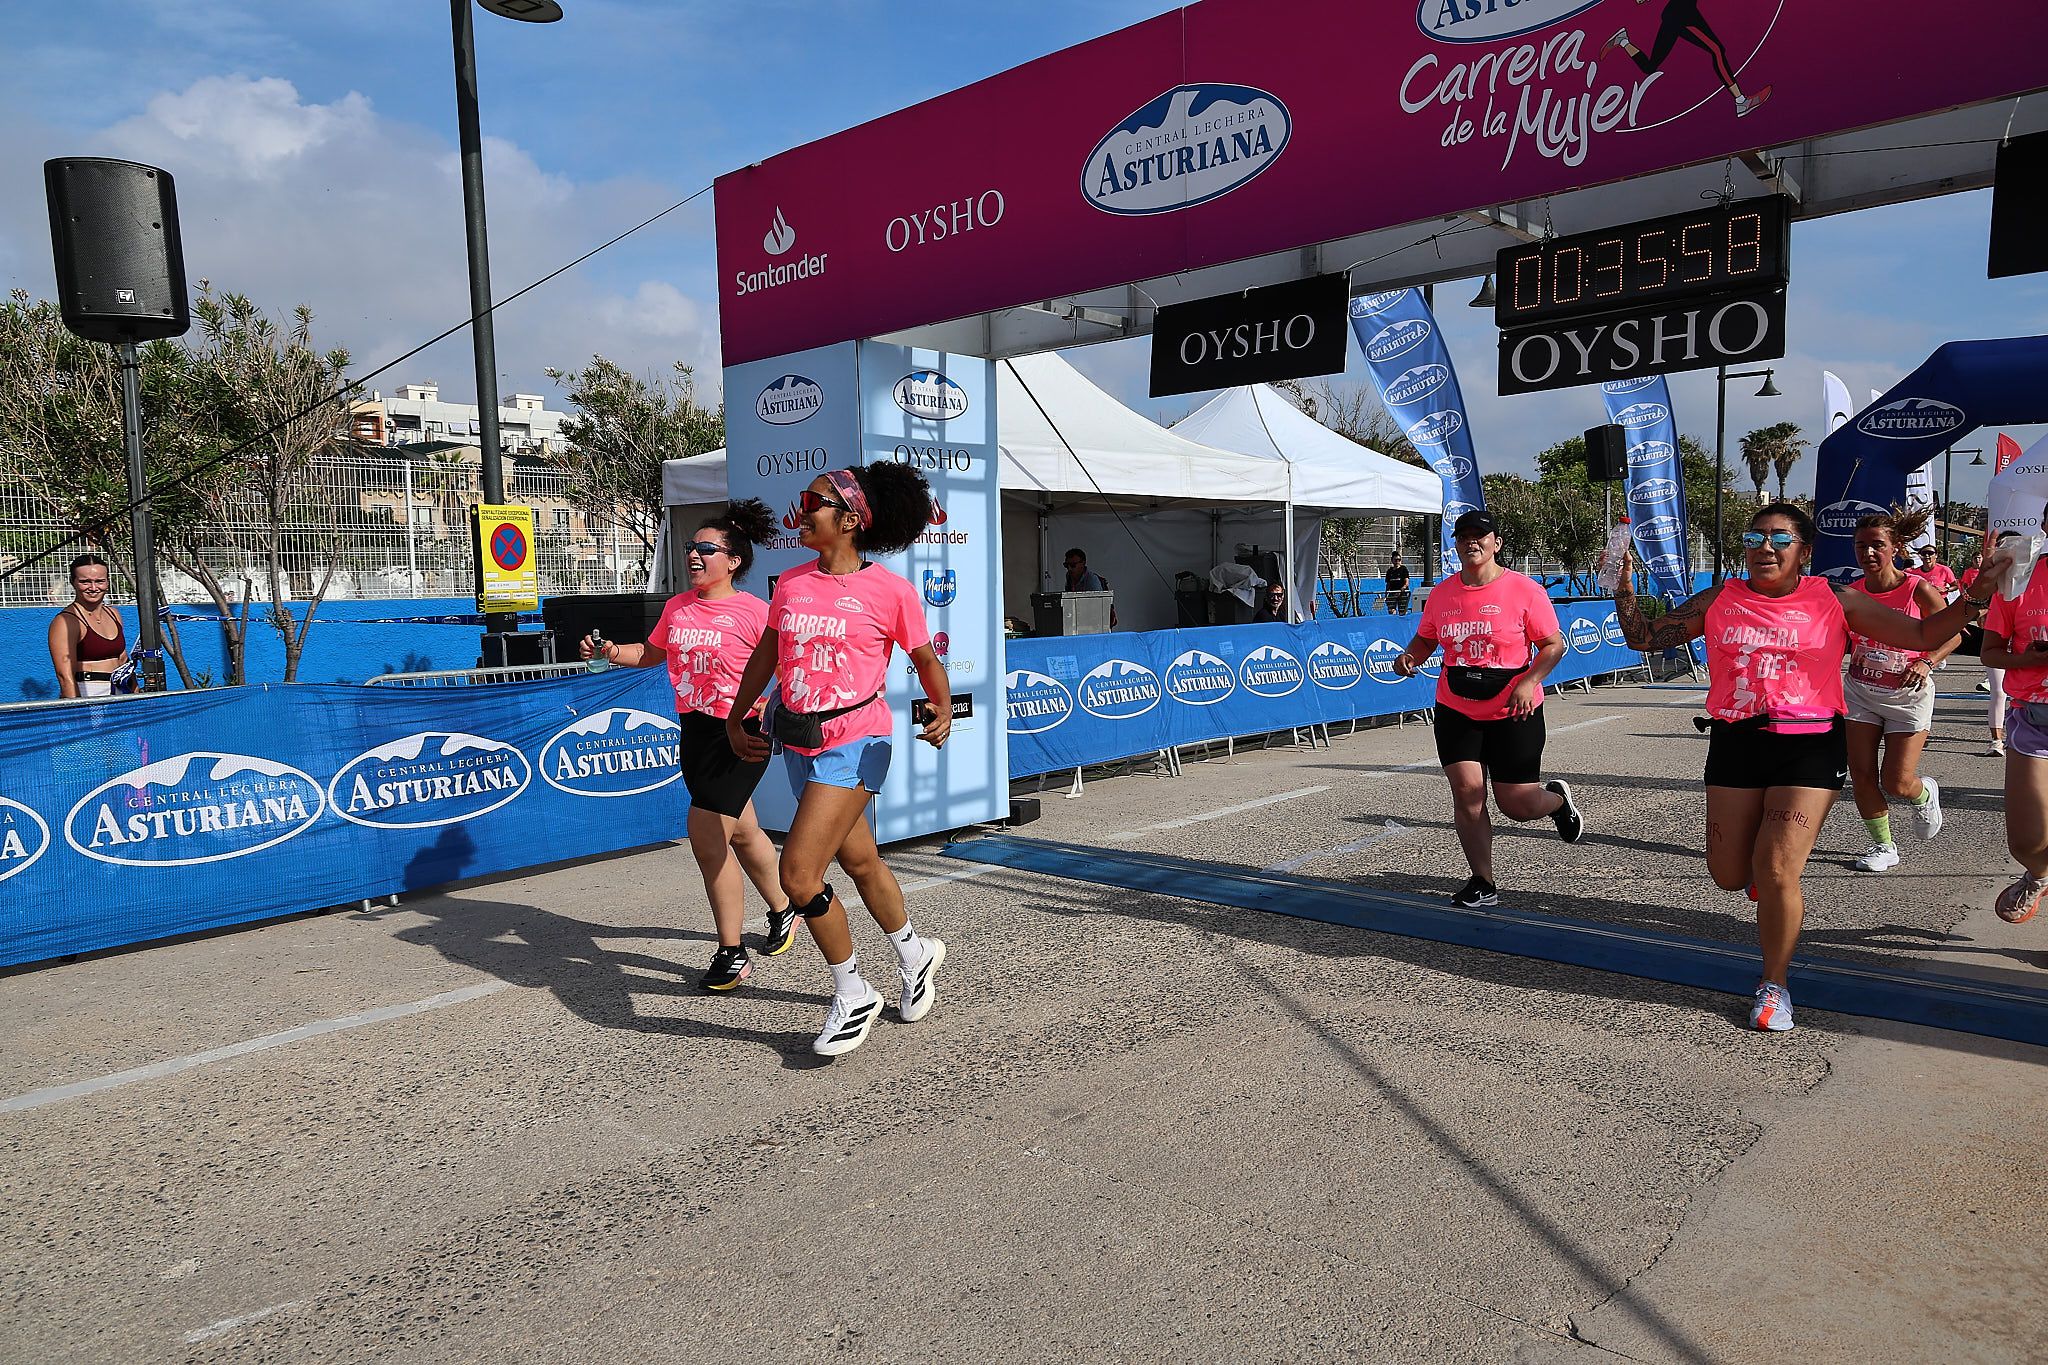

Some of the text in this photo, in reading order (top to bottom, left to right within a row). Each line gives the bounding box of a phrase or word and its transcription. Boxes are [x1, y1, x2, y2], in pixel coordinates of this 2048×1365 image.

[1399, 29, 1587, 114] Carrera
[1440, 96, 1508, 148] de la
[1501, 61, 1664, 172] Mujer
[1124, 106, 1266, 156] CENTRAL LECHERA
[1095, 123, 1274, 198] ASTURIANA
[885, 189, 1005, 252] OYSHO
[735, 251, 828, 296] Santander
[1179, 313, 1316, 365] OYSHO
[1511, 301, 1769, 383] OYSHO
[761, 395, 819, 416] ASTURIANA
[899, 385, 963, 410] ASTURIANA
[1863, 415, 1956, 430] ASTURIANA
[756, 447, 827, 477] OYSHO
[894, 445, 971, 472] OYSHO
[914, 529, 968, 544] antander
[1994, 517, 2037, 528] OYSHO
[925, 577, 955, 598] Marlene
[1172, 673, 1232, 694] ASTURIANA
[1246, 667, 1301, 686] ASTURIANA
[1313, 663, 1359, 680] ASTURIANA
[1006, 696, 1068, 719] TURIANA
[1086, 684, 1158, 708] ASTURIANA
[576, 731, 679, 751] CENTRAL LECHERA
[377, 753, 510, 779] CENTRAL LECHERA
[554, 744, 681, 781] ASTURIANA
[128, 779, 298, 809] CENTRAL LECHERA
[346, 765, 521, 813] ASTURIANA
[88, 793, 310, 849] ASTURIANA
